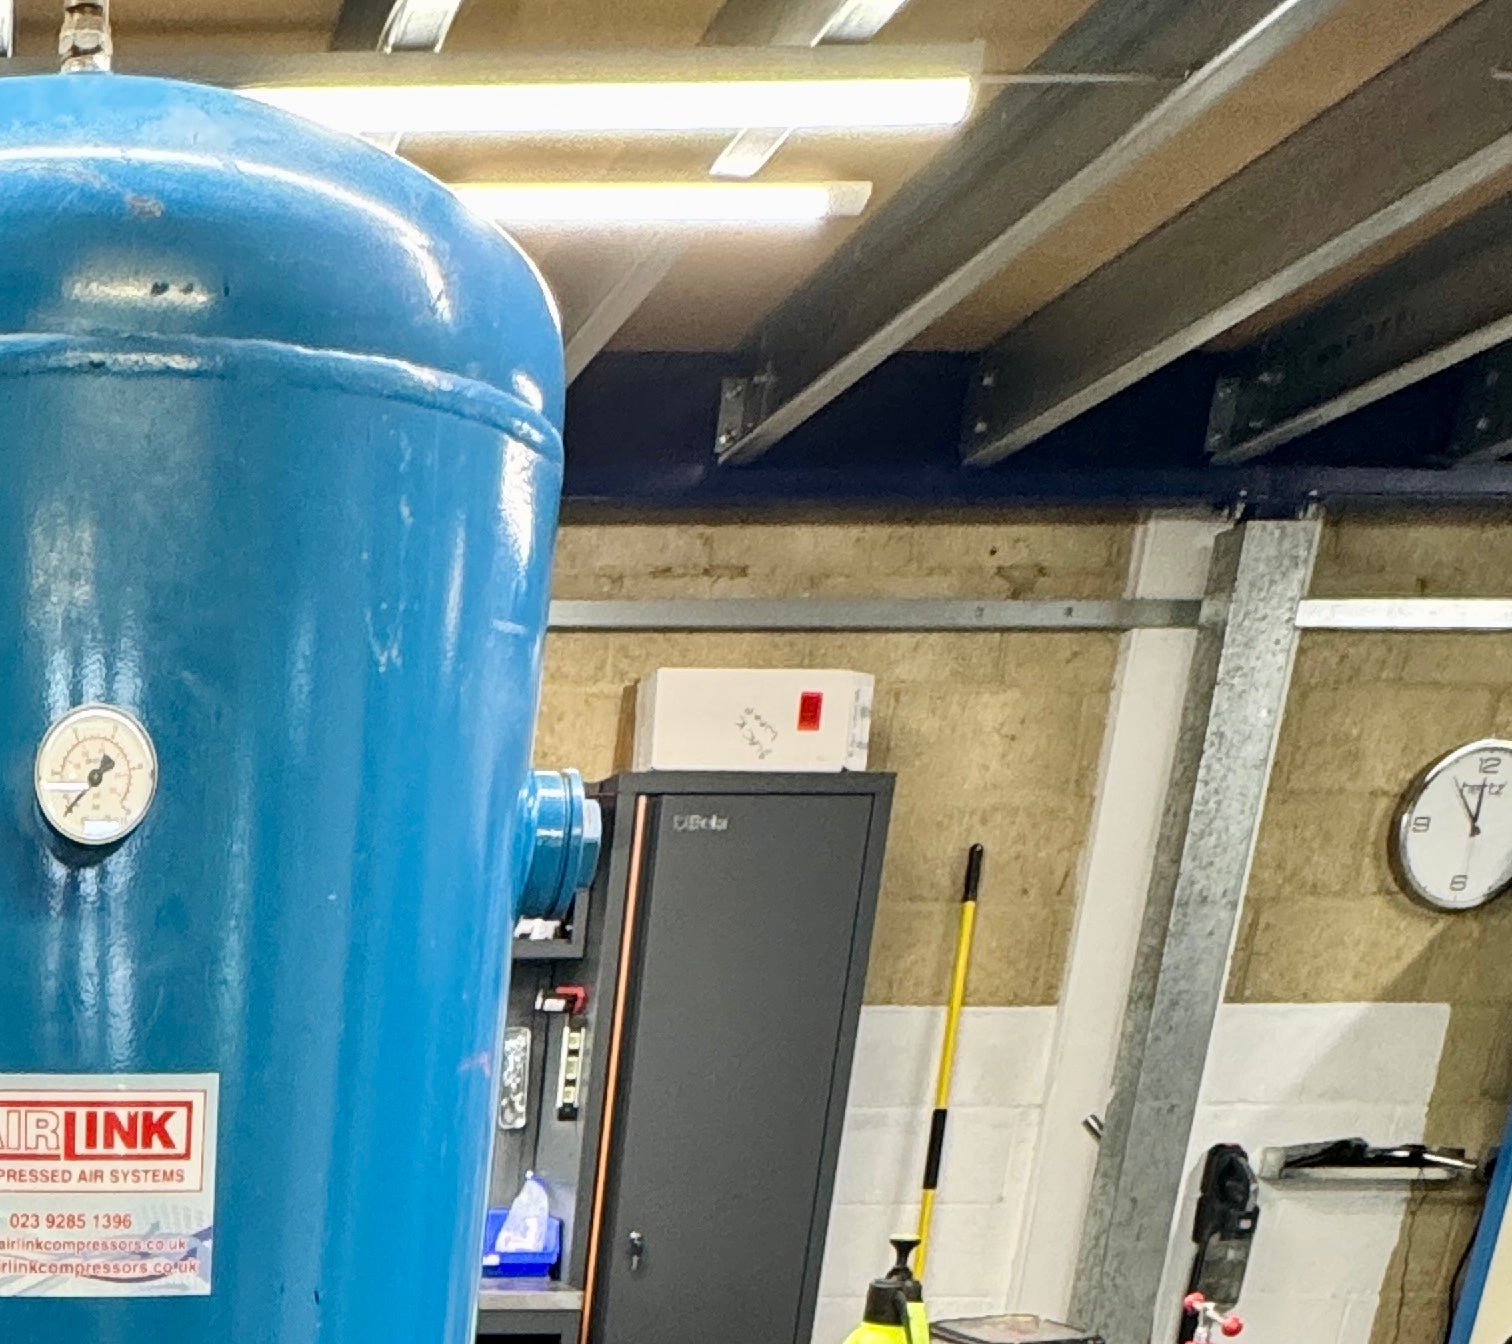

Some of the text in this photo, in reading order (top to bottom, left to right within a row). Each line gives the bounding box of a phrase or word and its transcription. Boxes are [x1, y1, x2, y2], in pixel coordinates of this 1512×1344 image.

[1478, 757, 1501, 774] 12
[1412, 816, 1432, 833] 9
[1449, 874, 1468, 891] 6
[77, 1168, 104, 1183] AIR
[110, 1168, 185, 1183] SYSTEMS
[9, 1213, 132, 1229] 023 9285 1396
